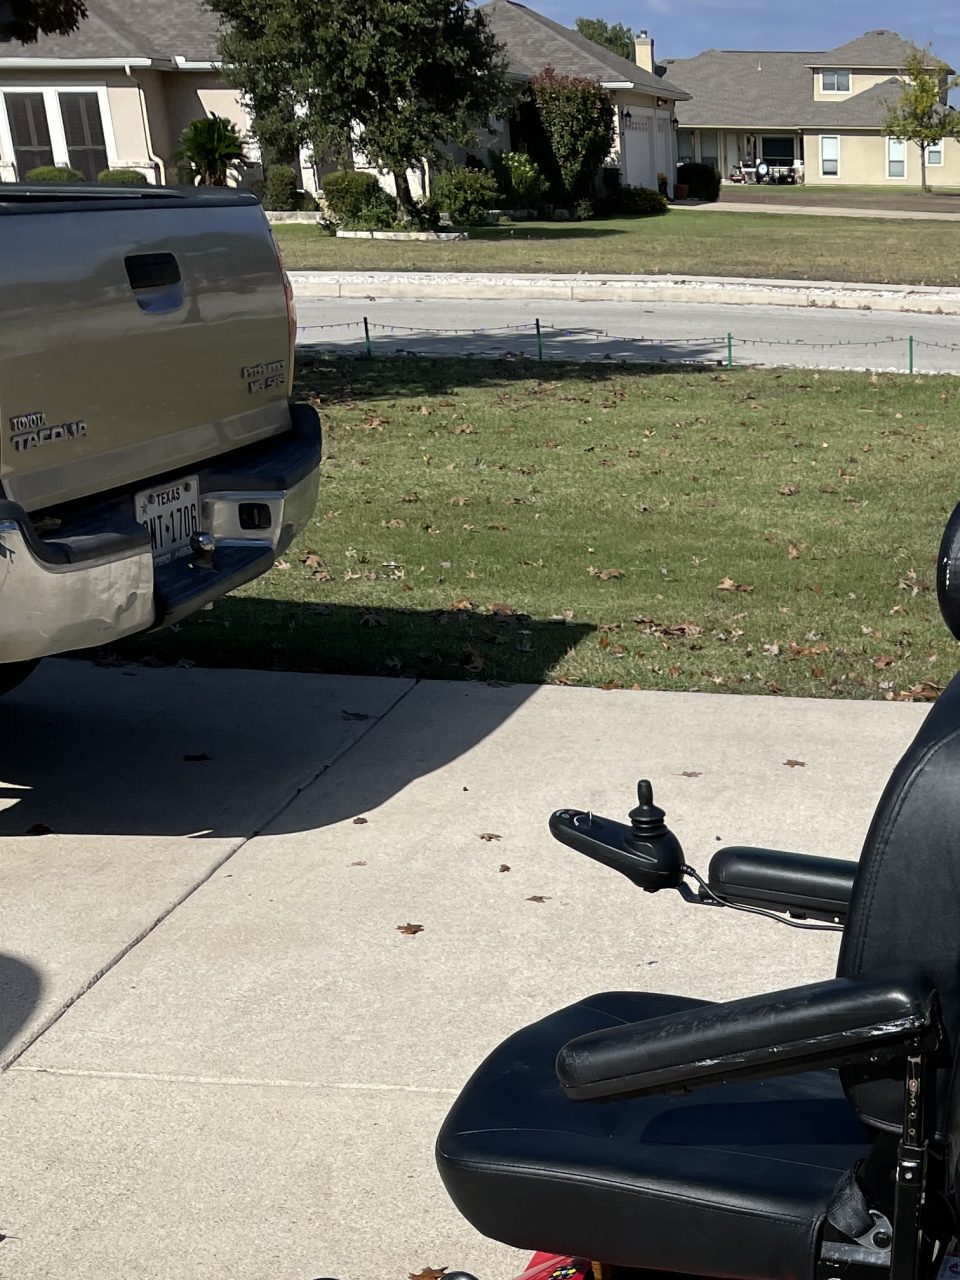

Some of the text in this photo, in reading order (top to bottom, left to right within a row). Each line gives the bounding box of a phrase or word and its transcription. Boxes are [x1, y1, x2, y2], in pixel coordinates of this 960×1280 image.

[10, 412, 46, 432] TOYOTA
[11, 420, 88, 452] TACOMA
[156, 487, 181, 507] TEXAS
